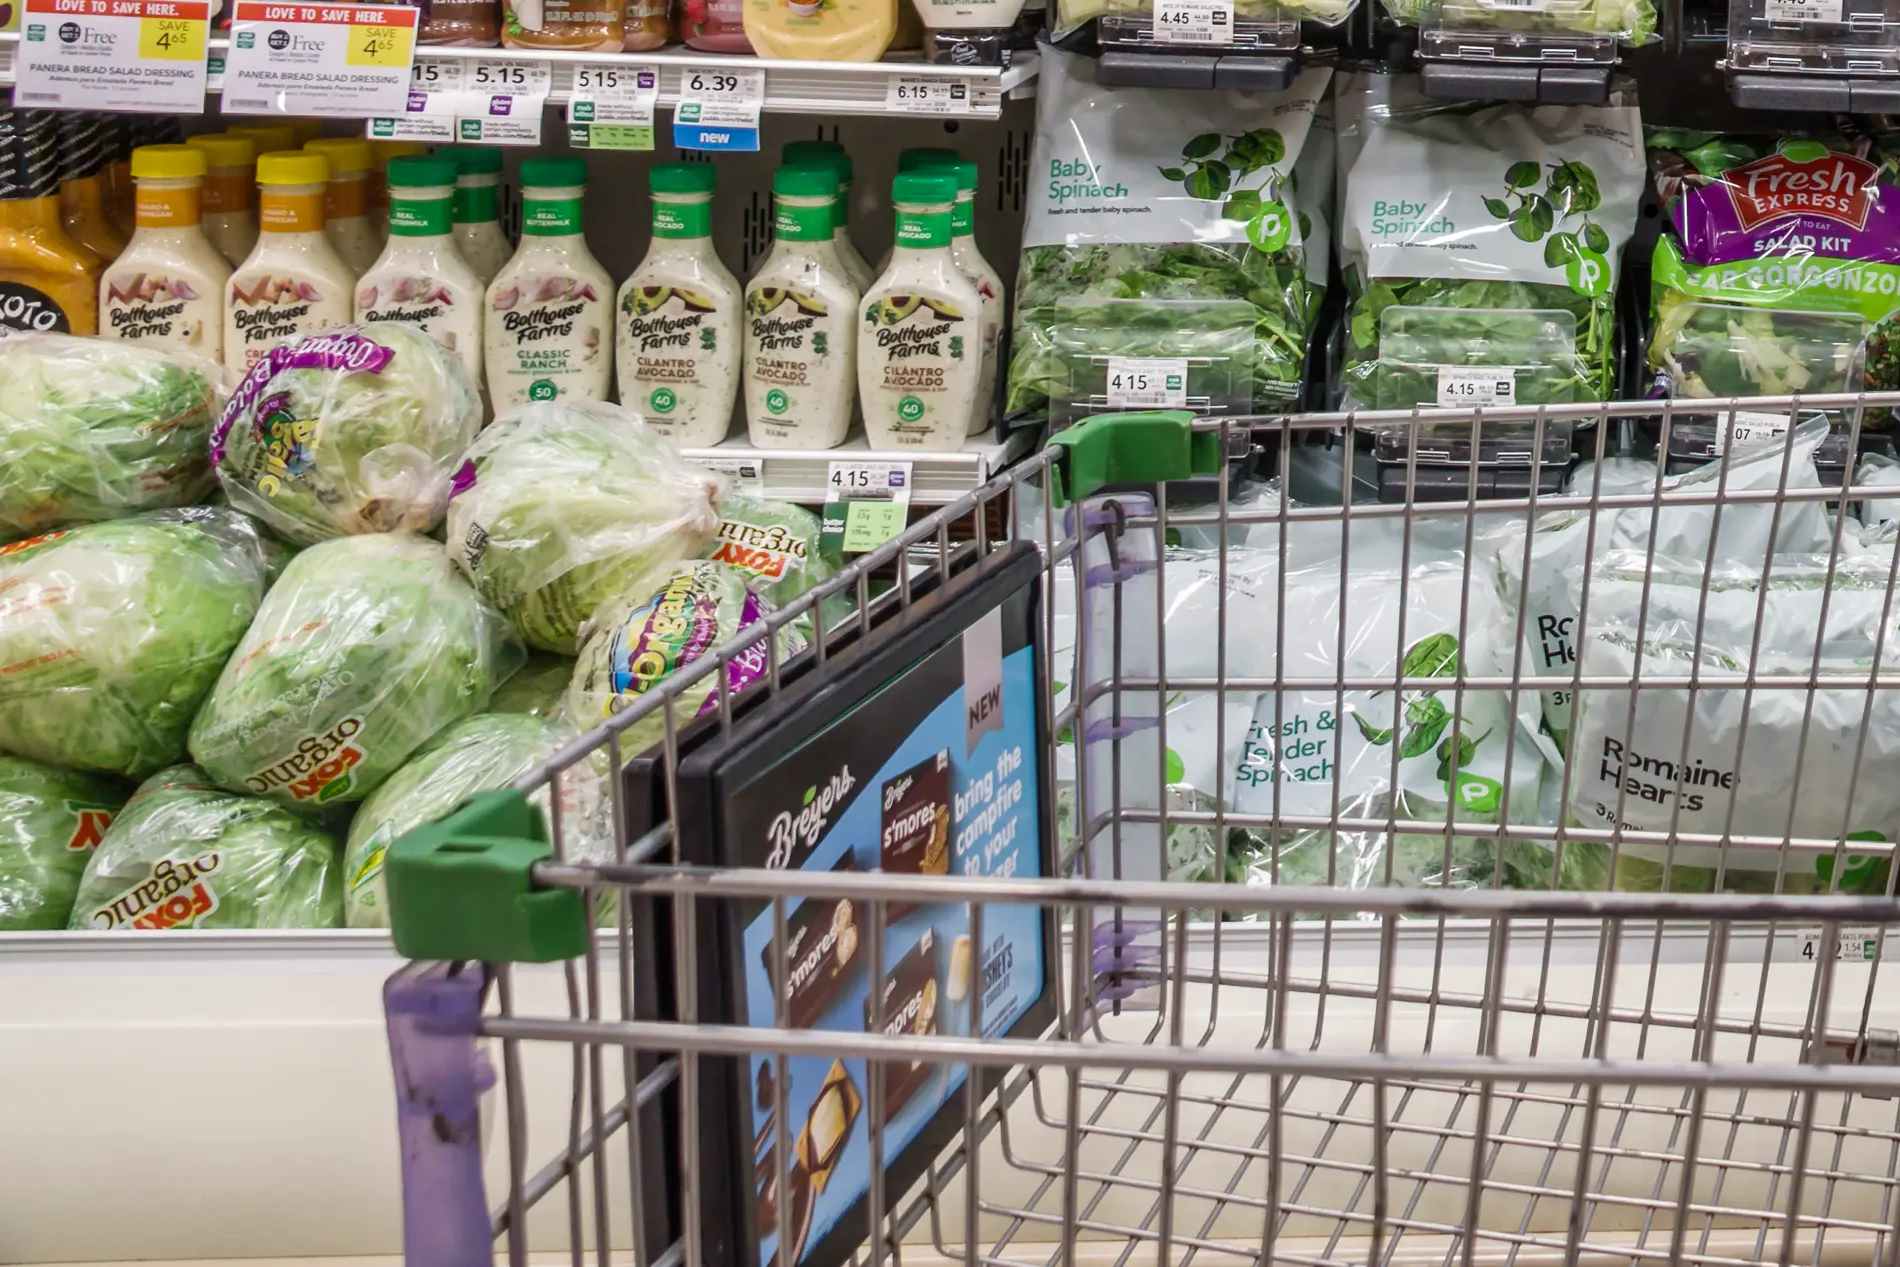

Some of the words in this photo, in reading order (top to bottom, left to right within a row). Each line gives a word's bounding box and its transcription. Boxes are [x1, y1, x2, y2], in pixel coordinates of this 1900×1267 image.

[1160, 11, 1189, 25] 4.45
[30, 63, 70, 74] PANERA
[73, 65, 106, 75] BREAD
[109, 67, 137, 76] SALAD
[141, 68, 195, 79] DRESSING
[690, 75, 738, 94] 6.39
[898, 86, 928, 100] 6.15
[700, 131, 730, 145] new
[1051, 158, 1102, 182] Baby
[1049, 182, 1128, 200] Spinach
[877, 323, 950, 346] Bolthouse
[517, 350, 570, 359] CLASSIC
[889, 341, 938, 360] Farms
[521, 360, 566, 369] RANCH
[637, 358, 695, 369] CILANTRO
[637, 368, 695, 379] AVOCADO
[1112, 375, 1147, 391] 4.15
[536, 387, 550, 398] 50
[656, 395, 670, 405] 40
[832, 470, 869, 488] 4.15
[968, 685, 1000, 729] NEW
[955, 770, 994, 823] bring
[996, 746, 1022, 782] the
[766, 764, 855, 869] Breyers
[884, 802, 936, 848] s'mores
[956, 780, 1022, 855] campfire
[984, 817, 1018, 870] your
